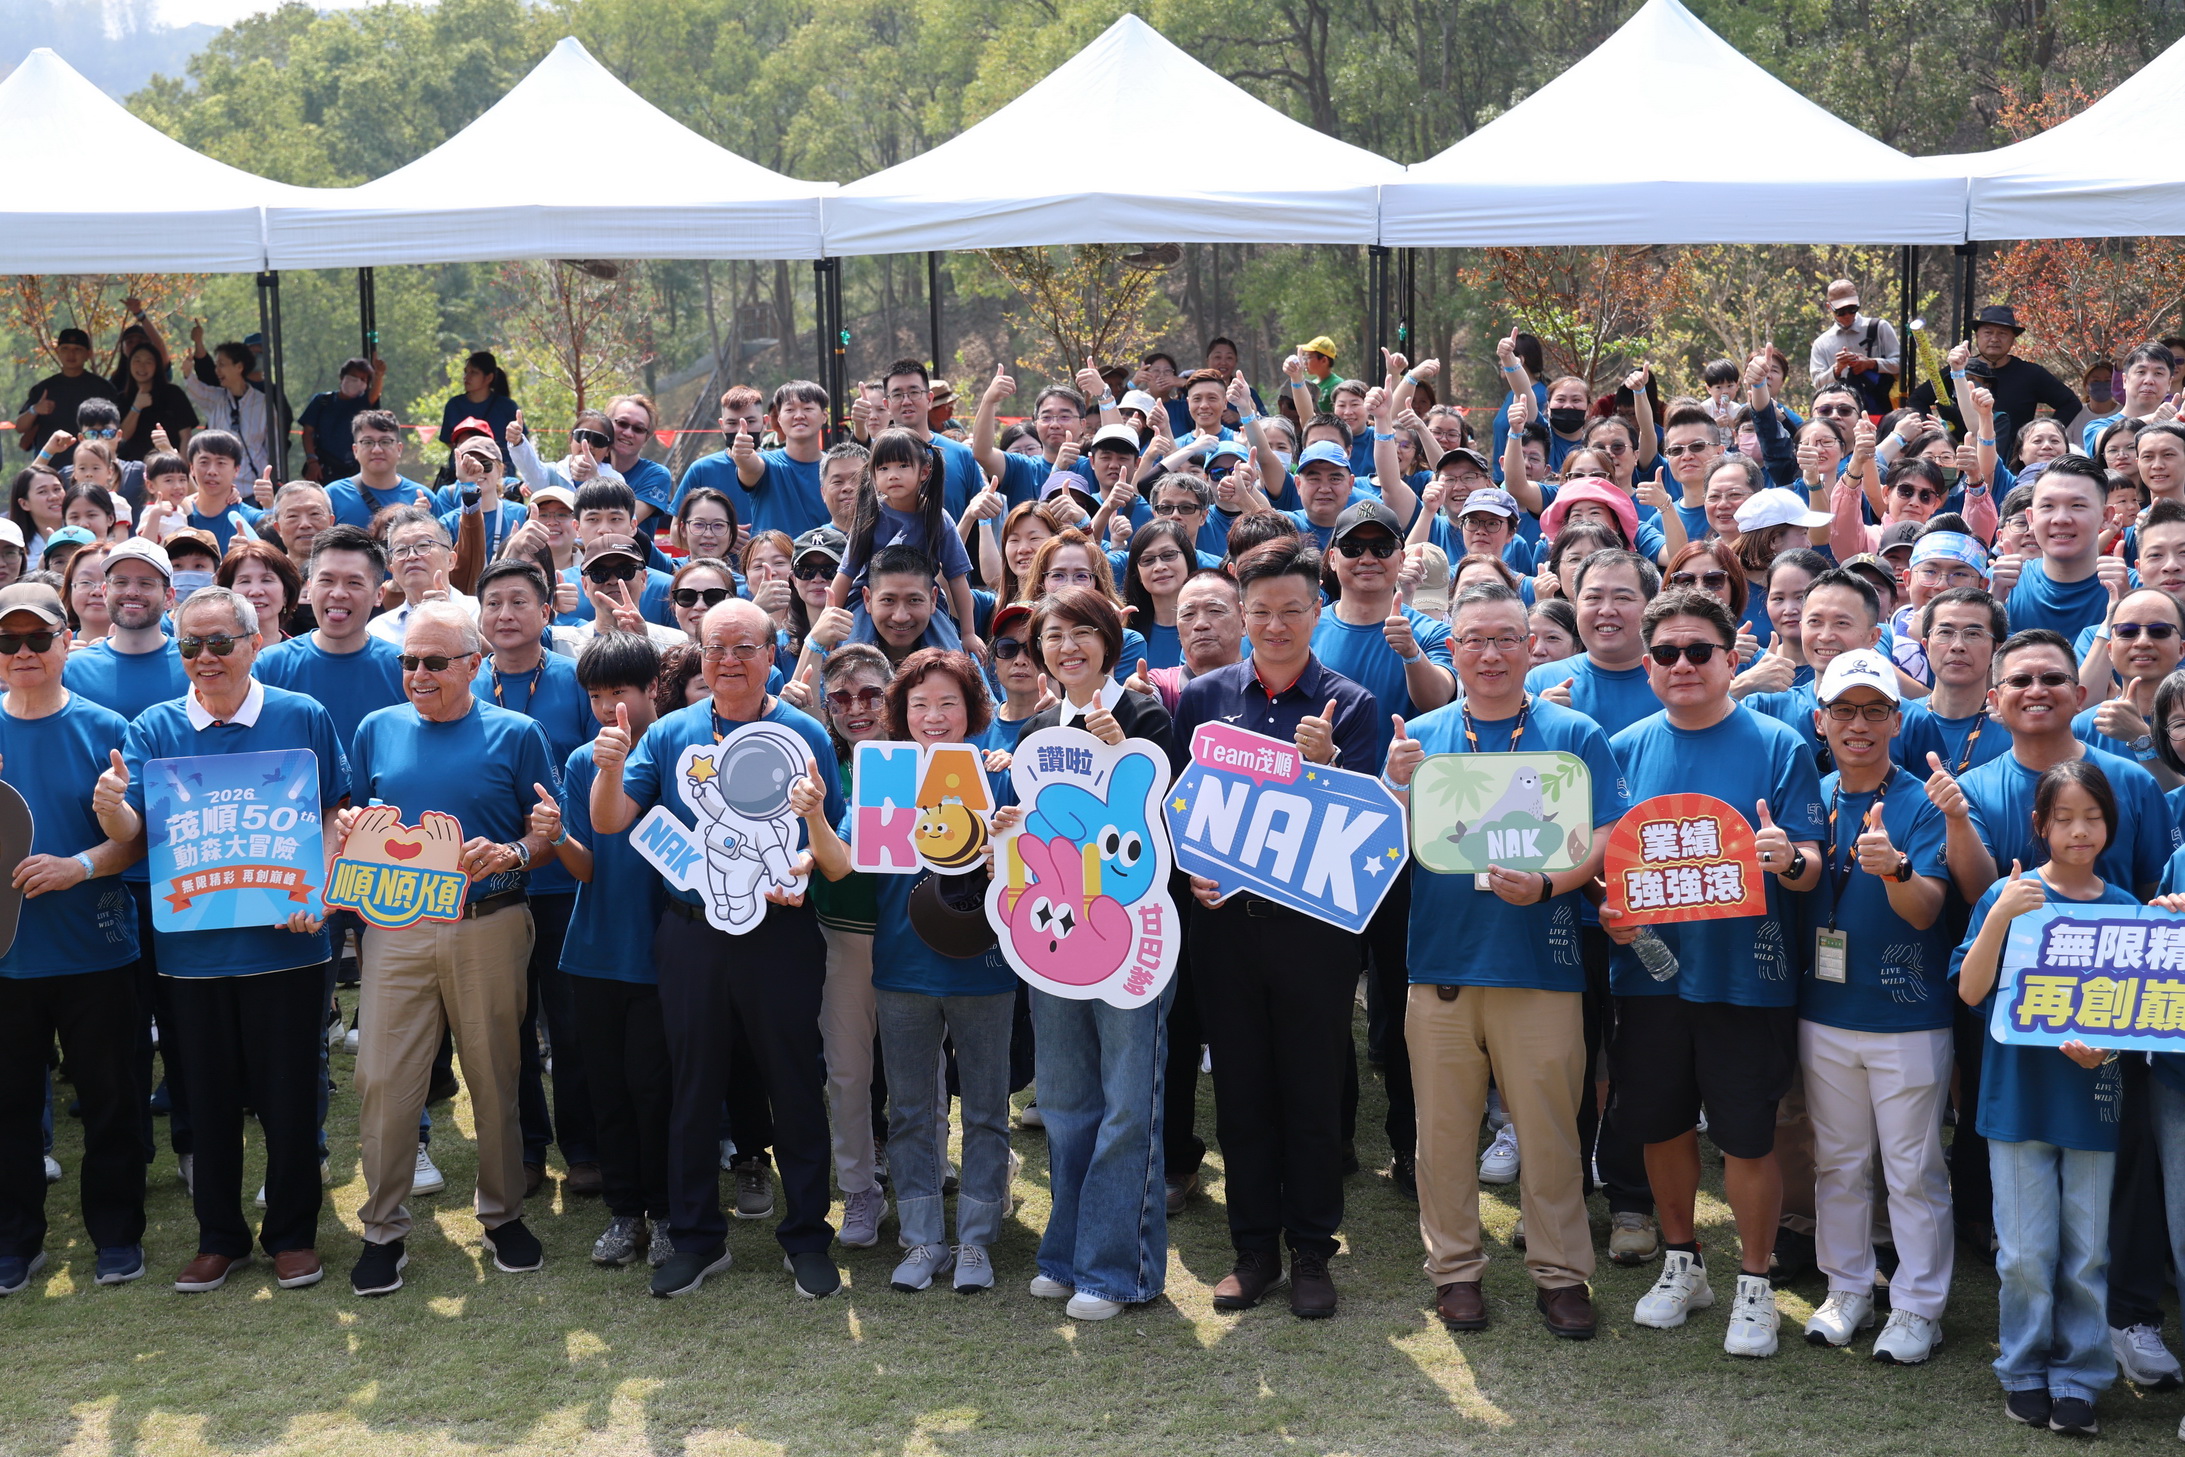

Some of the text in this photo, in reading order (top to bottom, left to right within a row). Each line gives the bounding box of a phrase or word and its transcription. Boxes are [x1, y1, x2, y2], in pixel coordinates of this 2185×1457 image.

[1037, 746, 1093, 776] 讚啦
[1200, 735, 1294, 778] Team茂順
[210, 788, 256, 803] 2026
[639, 815, 705, 881] NAK
[1185, 774, 1390, 916] NAK
[1487, 828, 1543, 860] NAK
[1642, 819, 1719, 862] 業績
[173, 834, 301, 871] 動森大冒險
[181, 869, 297, 894] 無限精彩 再創巔峰
[1627, 864, 1745, 909] 強強滾
[97, 911, 110, 919] LIVE
[98, 920, 115, 928] WILD
[1753, 942, 1773, 951] LIVE
[1753, 952, 1774, 961] WILD
[1880, 967, 1901, 975] LIVE
[1881, 977, 1905, 985] WILD
[2095, 1083, 2111, 1091] LIVE
[2094, 1093, 2113, 1102] WILD
